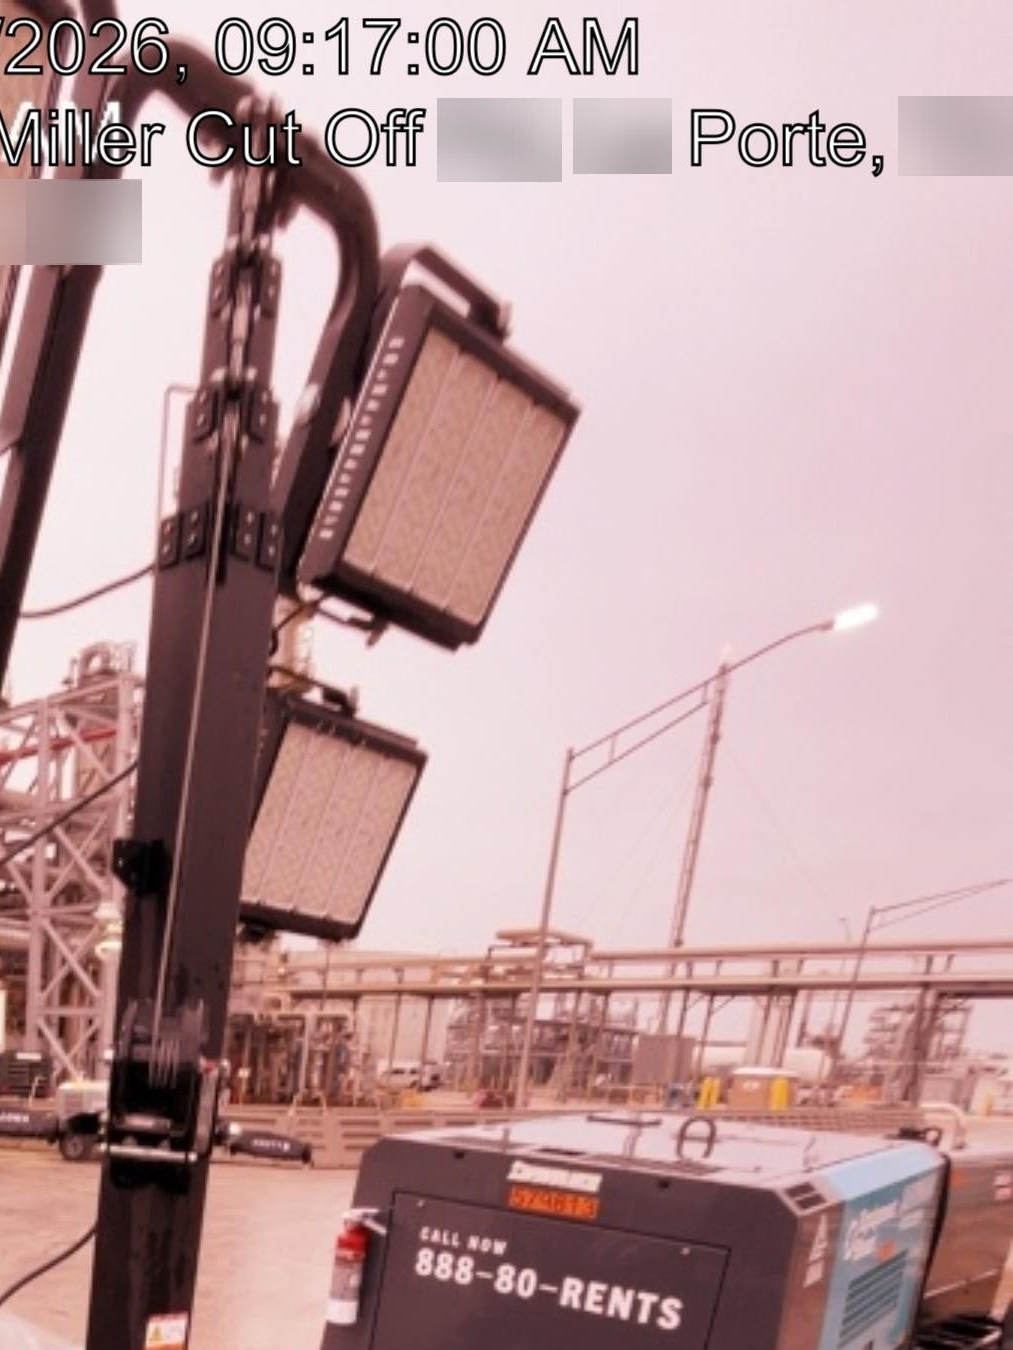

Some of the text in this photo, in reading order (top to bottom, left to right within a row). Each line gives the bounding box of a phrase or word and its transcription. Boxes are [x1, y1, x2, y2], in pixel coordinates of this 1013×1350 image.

[420, 1225, 508, 1256] CALL NOW
[414, 1247, 685, 1331] 888-80-RENTS
